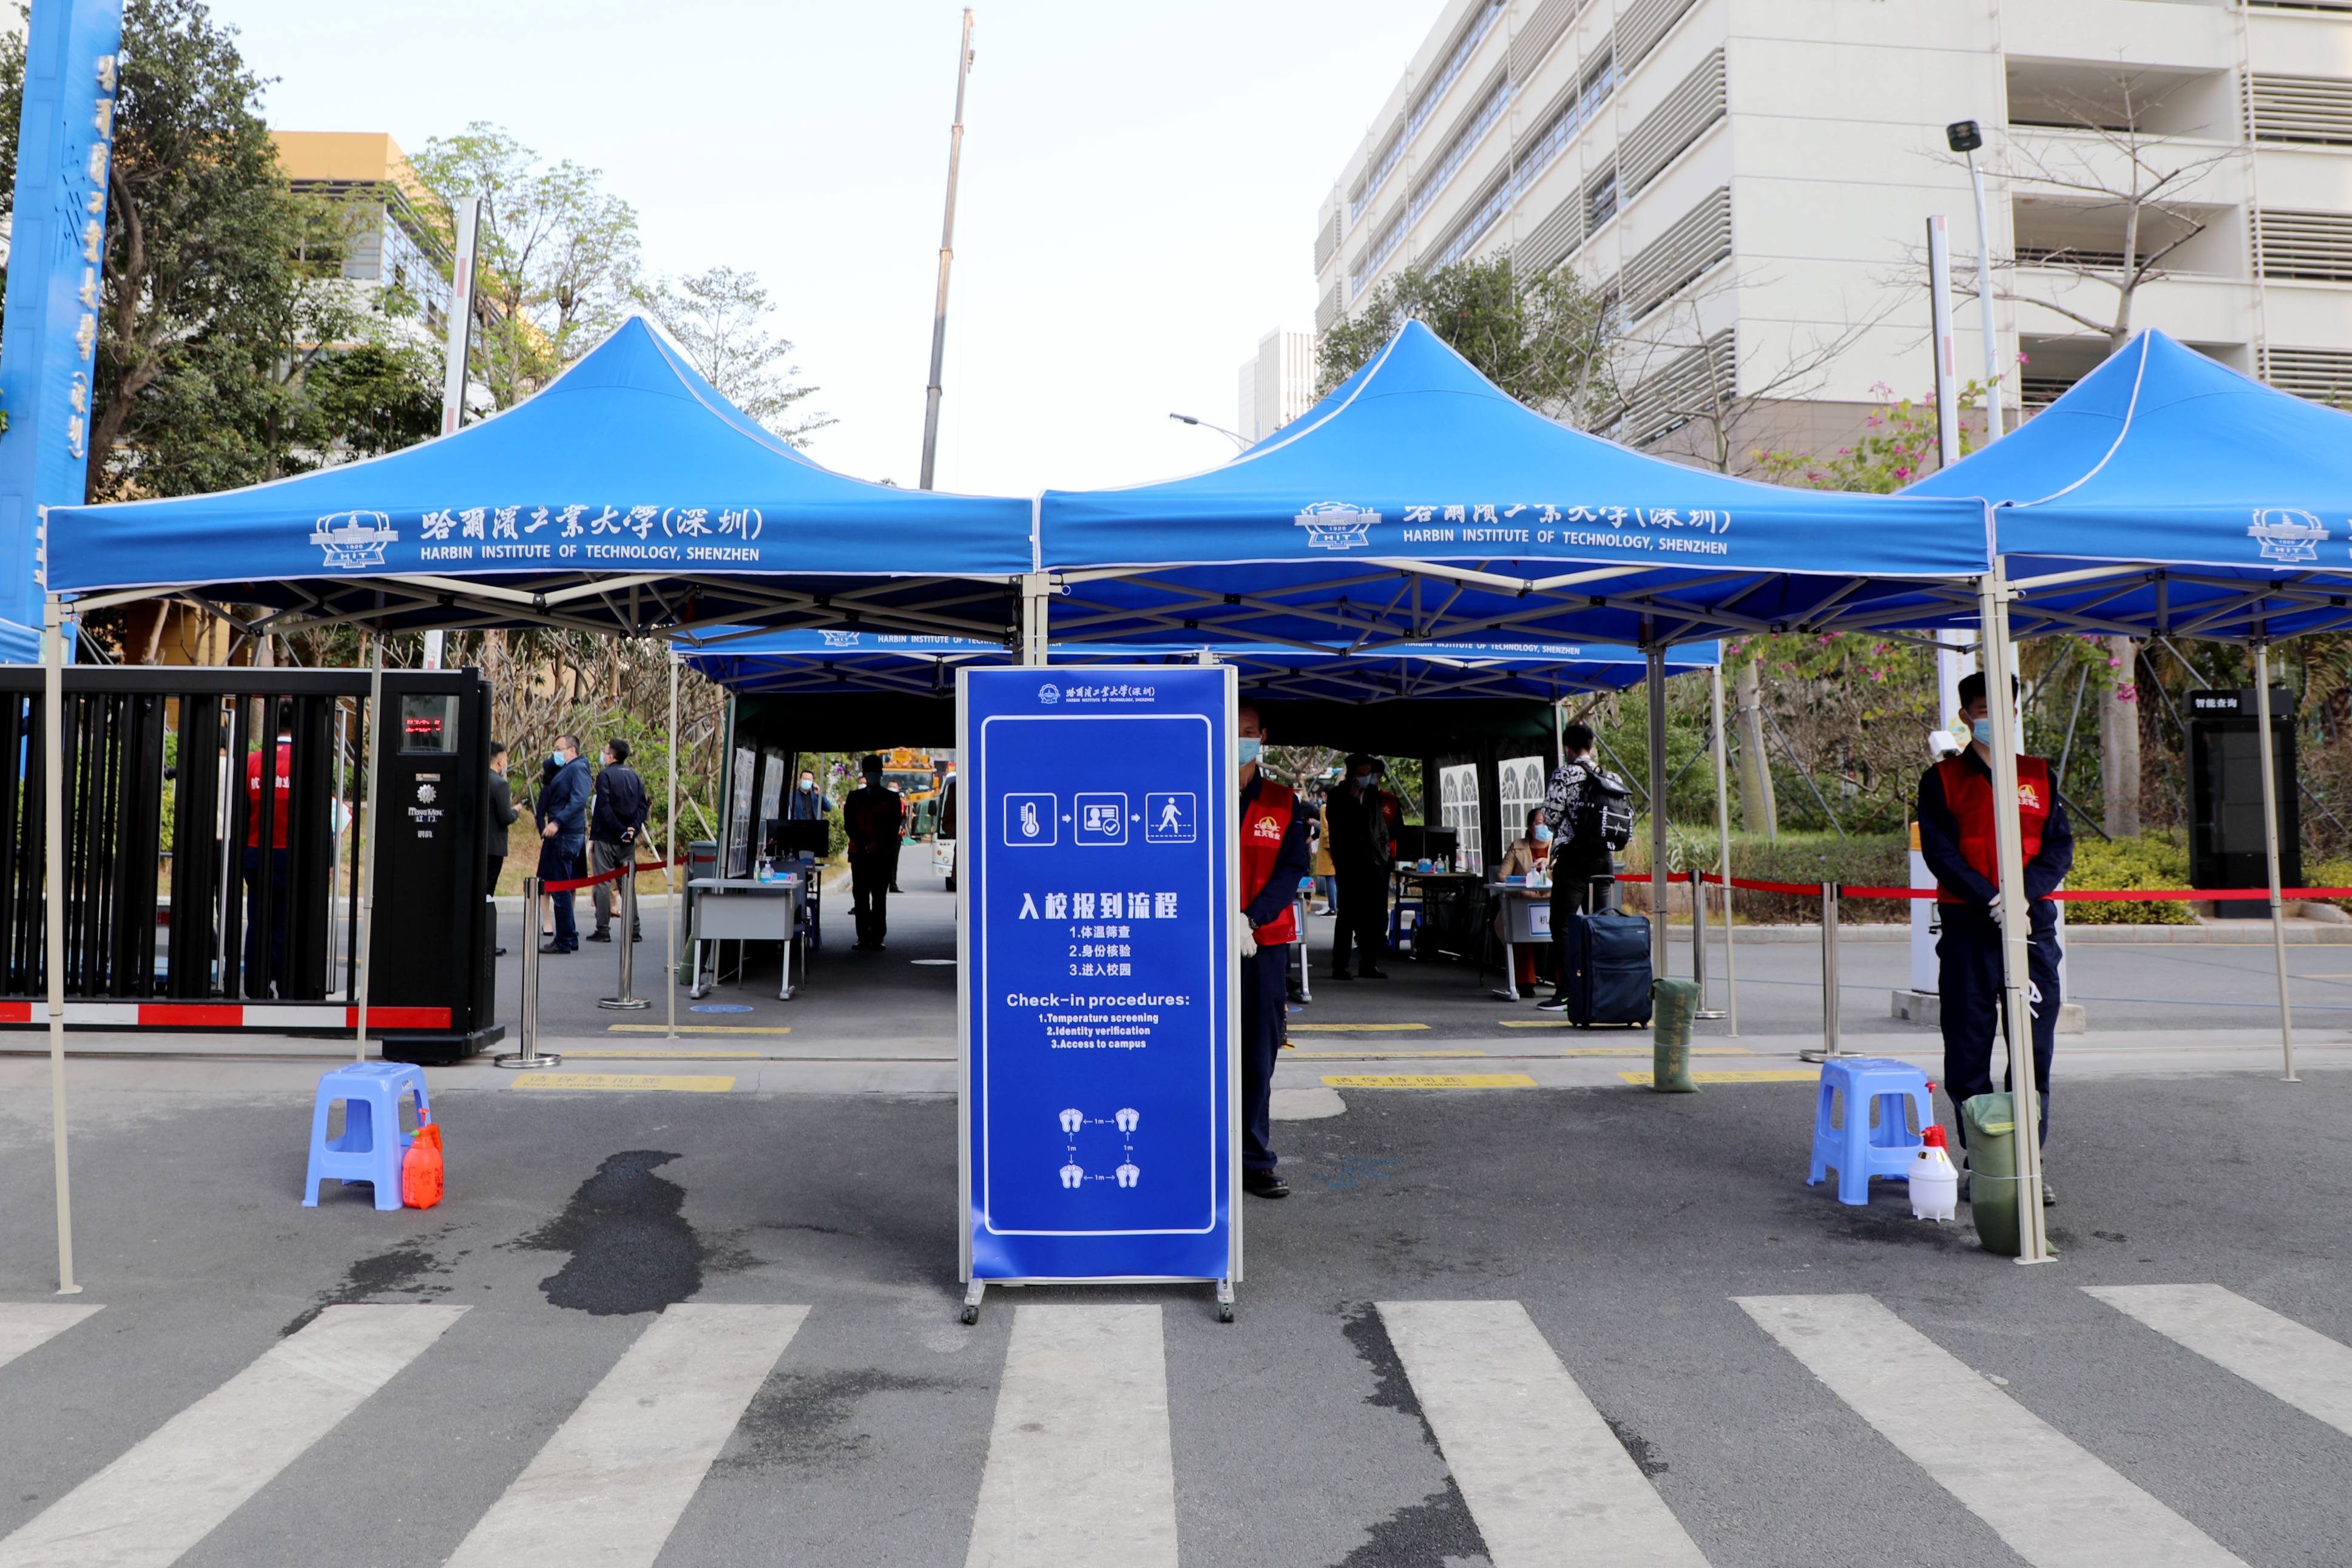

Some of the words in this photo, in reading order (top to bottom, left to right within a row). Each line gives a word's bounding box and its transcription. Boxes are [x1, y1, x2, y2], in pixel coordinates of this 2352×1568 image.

[1403, 529, 1454, 542] HARBIN
[1462, 528, 1529, 543] INSTITUTE
[1537, 529, 1555, 543] OF
[1564, 531, 1654, 552] TECHNOLOGY,
[1658, 536, 1728, 555] SHENZHEN
[421, 546, 473, 559] HARBIN
[481, 544, 550, 559] INSTITUTE
[559, 544, 577, 558] OF
[586, 544, 681, 561] TECHNOLOGY,
[686, 546, 760, 561] SHENZHEN
[878, 635, 907, 643] HARBIN
[911, 635, 949, 643] INSTITUTE
[1491, 644, 1540, 653] TECHNOLOGY,
[1542, 646, 1580, 655] SHENZHEN
[1254, 829, 1280, 840] 航天物业
[1018, 892, 1178, 920] 入校报到流程
[1069, 925, 1130, 939] 1.体温筛查
[1069, 944, 1131, 958] 2.身份核验
[1069, 963, 1131, 976] 3.进入校园
[1007, 993, 1085, 1007] Check-in
[1089, 993, 1190, 1009] procedures:
[1038, 1013, 1109, 1025] 1.Temperature
[1110, 1013, 1159, 1024] screening
[1046, 1026, 1093, 1037] 2.Identity
[1095, 1026, 1151, 1035] verification
[1051, 1039, 1095, 1049] 3.Access
[1097, 1039, 1107, 1048] to
[1108, 1039, 1146, 1050] campus
[529, 1075, 663, 1084] 请保持间距
